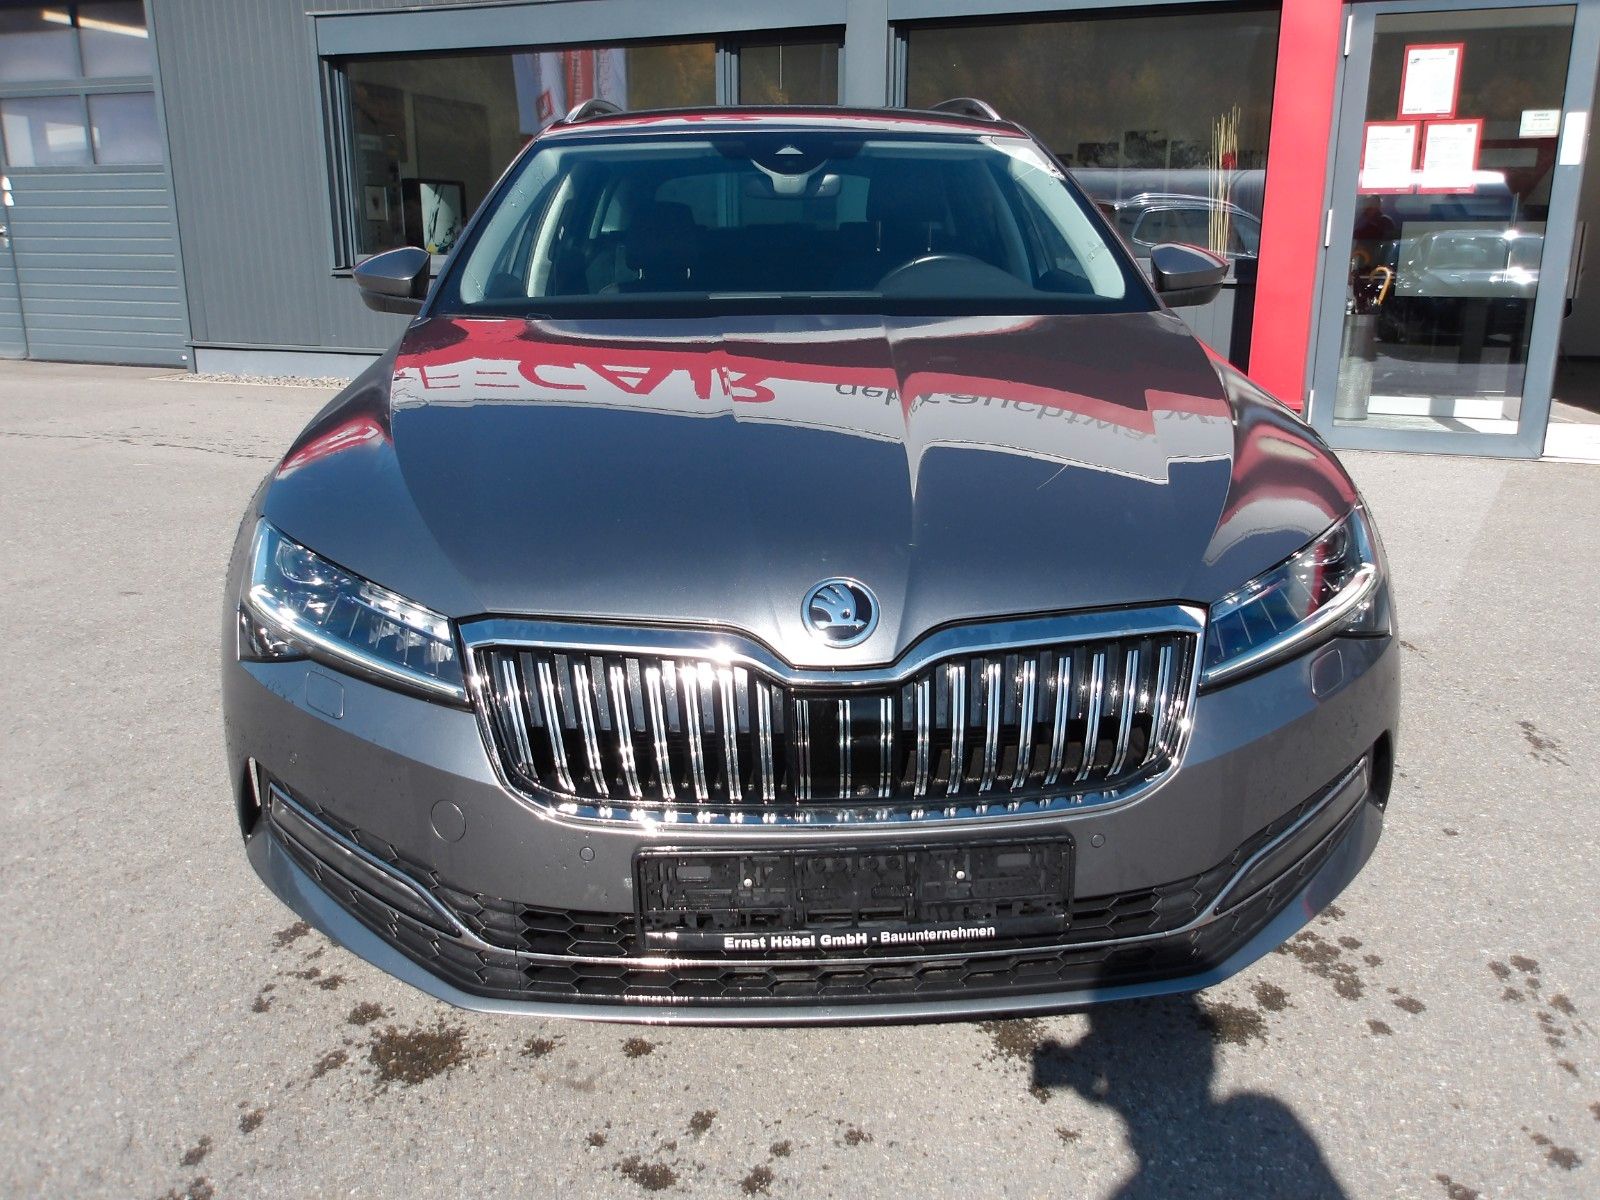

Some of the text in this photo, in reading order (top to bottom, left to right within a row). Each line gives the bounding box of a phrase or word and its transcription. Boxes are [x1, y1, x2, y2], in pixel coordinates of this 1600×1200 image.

[723, 936, 767, 949] Ernst
[770, 934, 816, 949] Höbel
[820, 932, 868, 946] GmbH
[880, 926, 996, 943] Bauunternehmen
